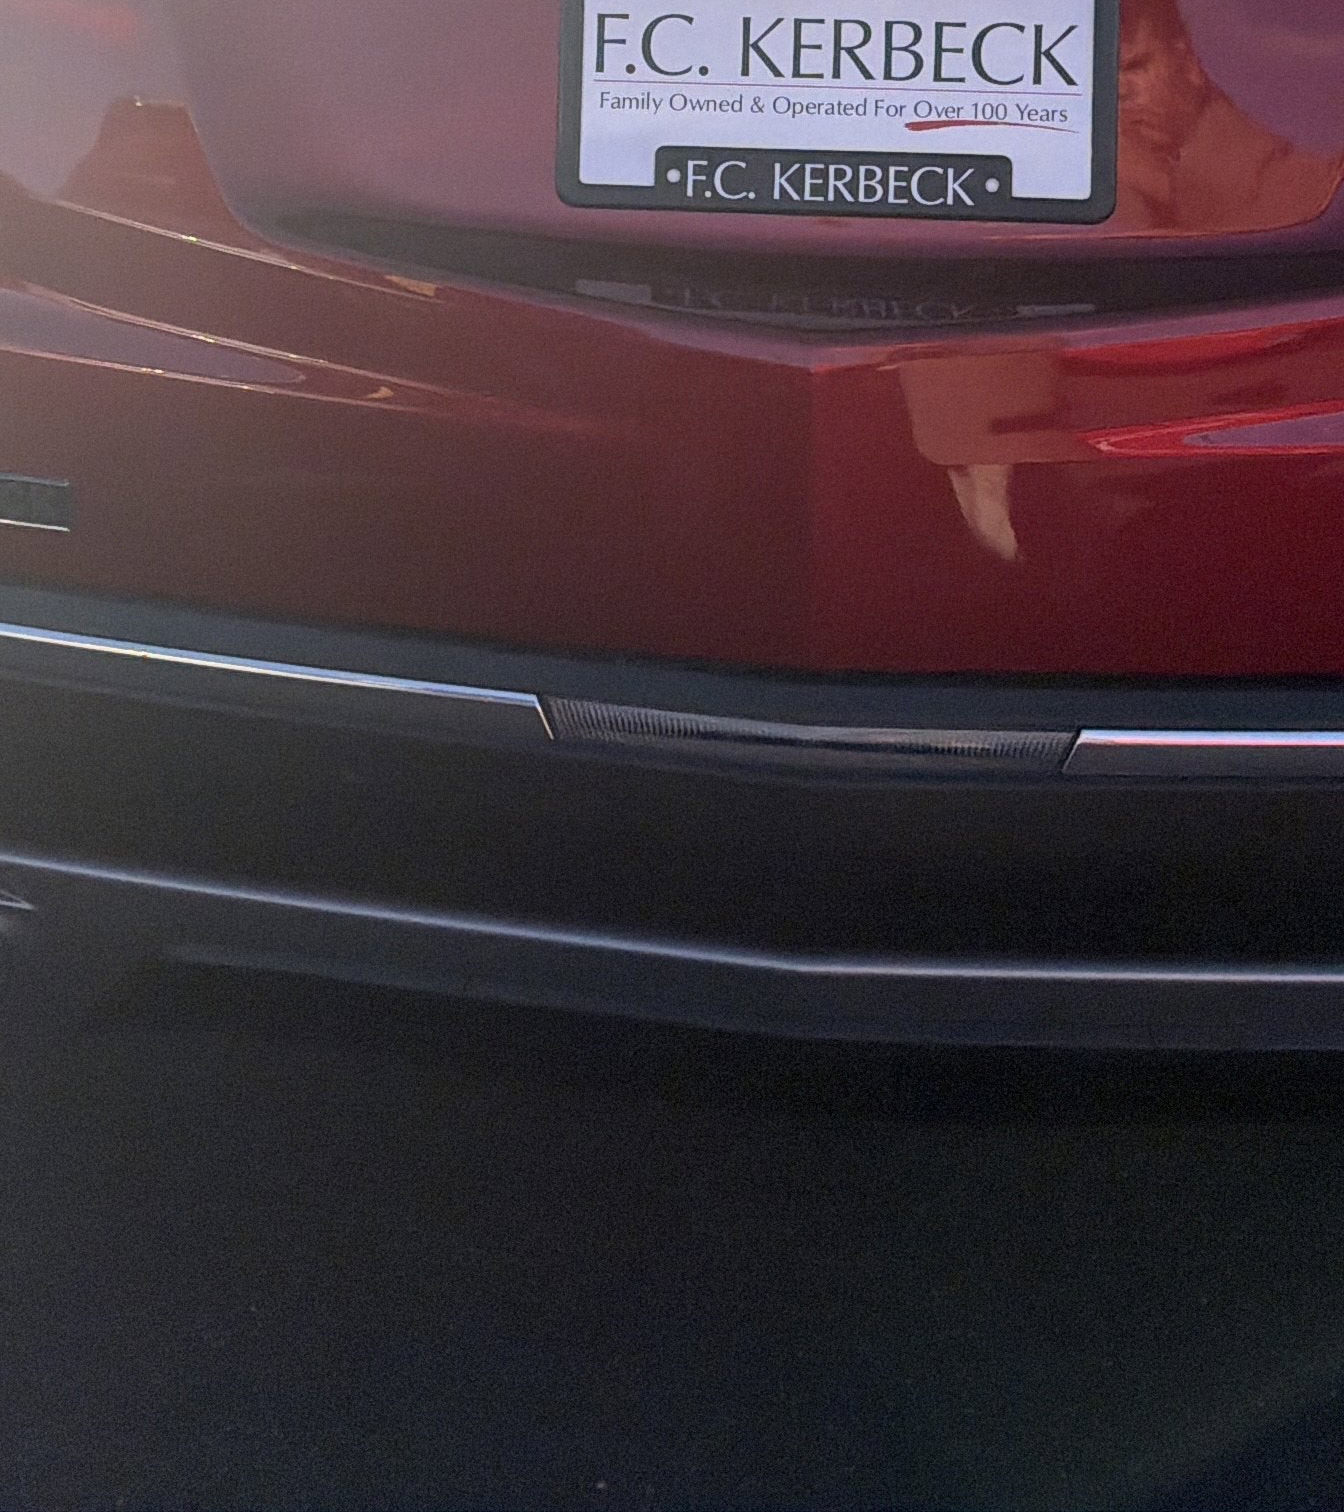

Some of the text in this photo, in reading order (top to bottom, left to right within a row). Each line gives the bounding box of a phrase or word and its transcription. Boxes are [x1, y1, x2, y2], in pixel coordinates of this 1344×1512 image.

[594, 11, 1079, 88] F.C. KERBECK
[599, 90, 1068, 123] Family Owned & Operated For Over 100 Years
[685, 159, 976, 207] F.C. KERBECK
